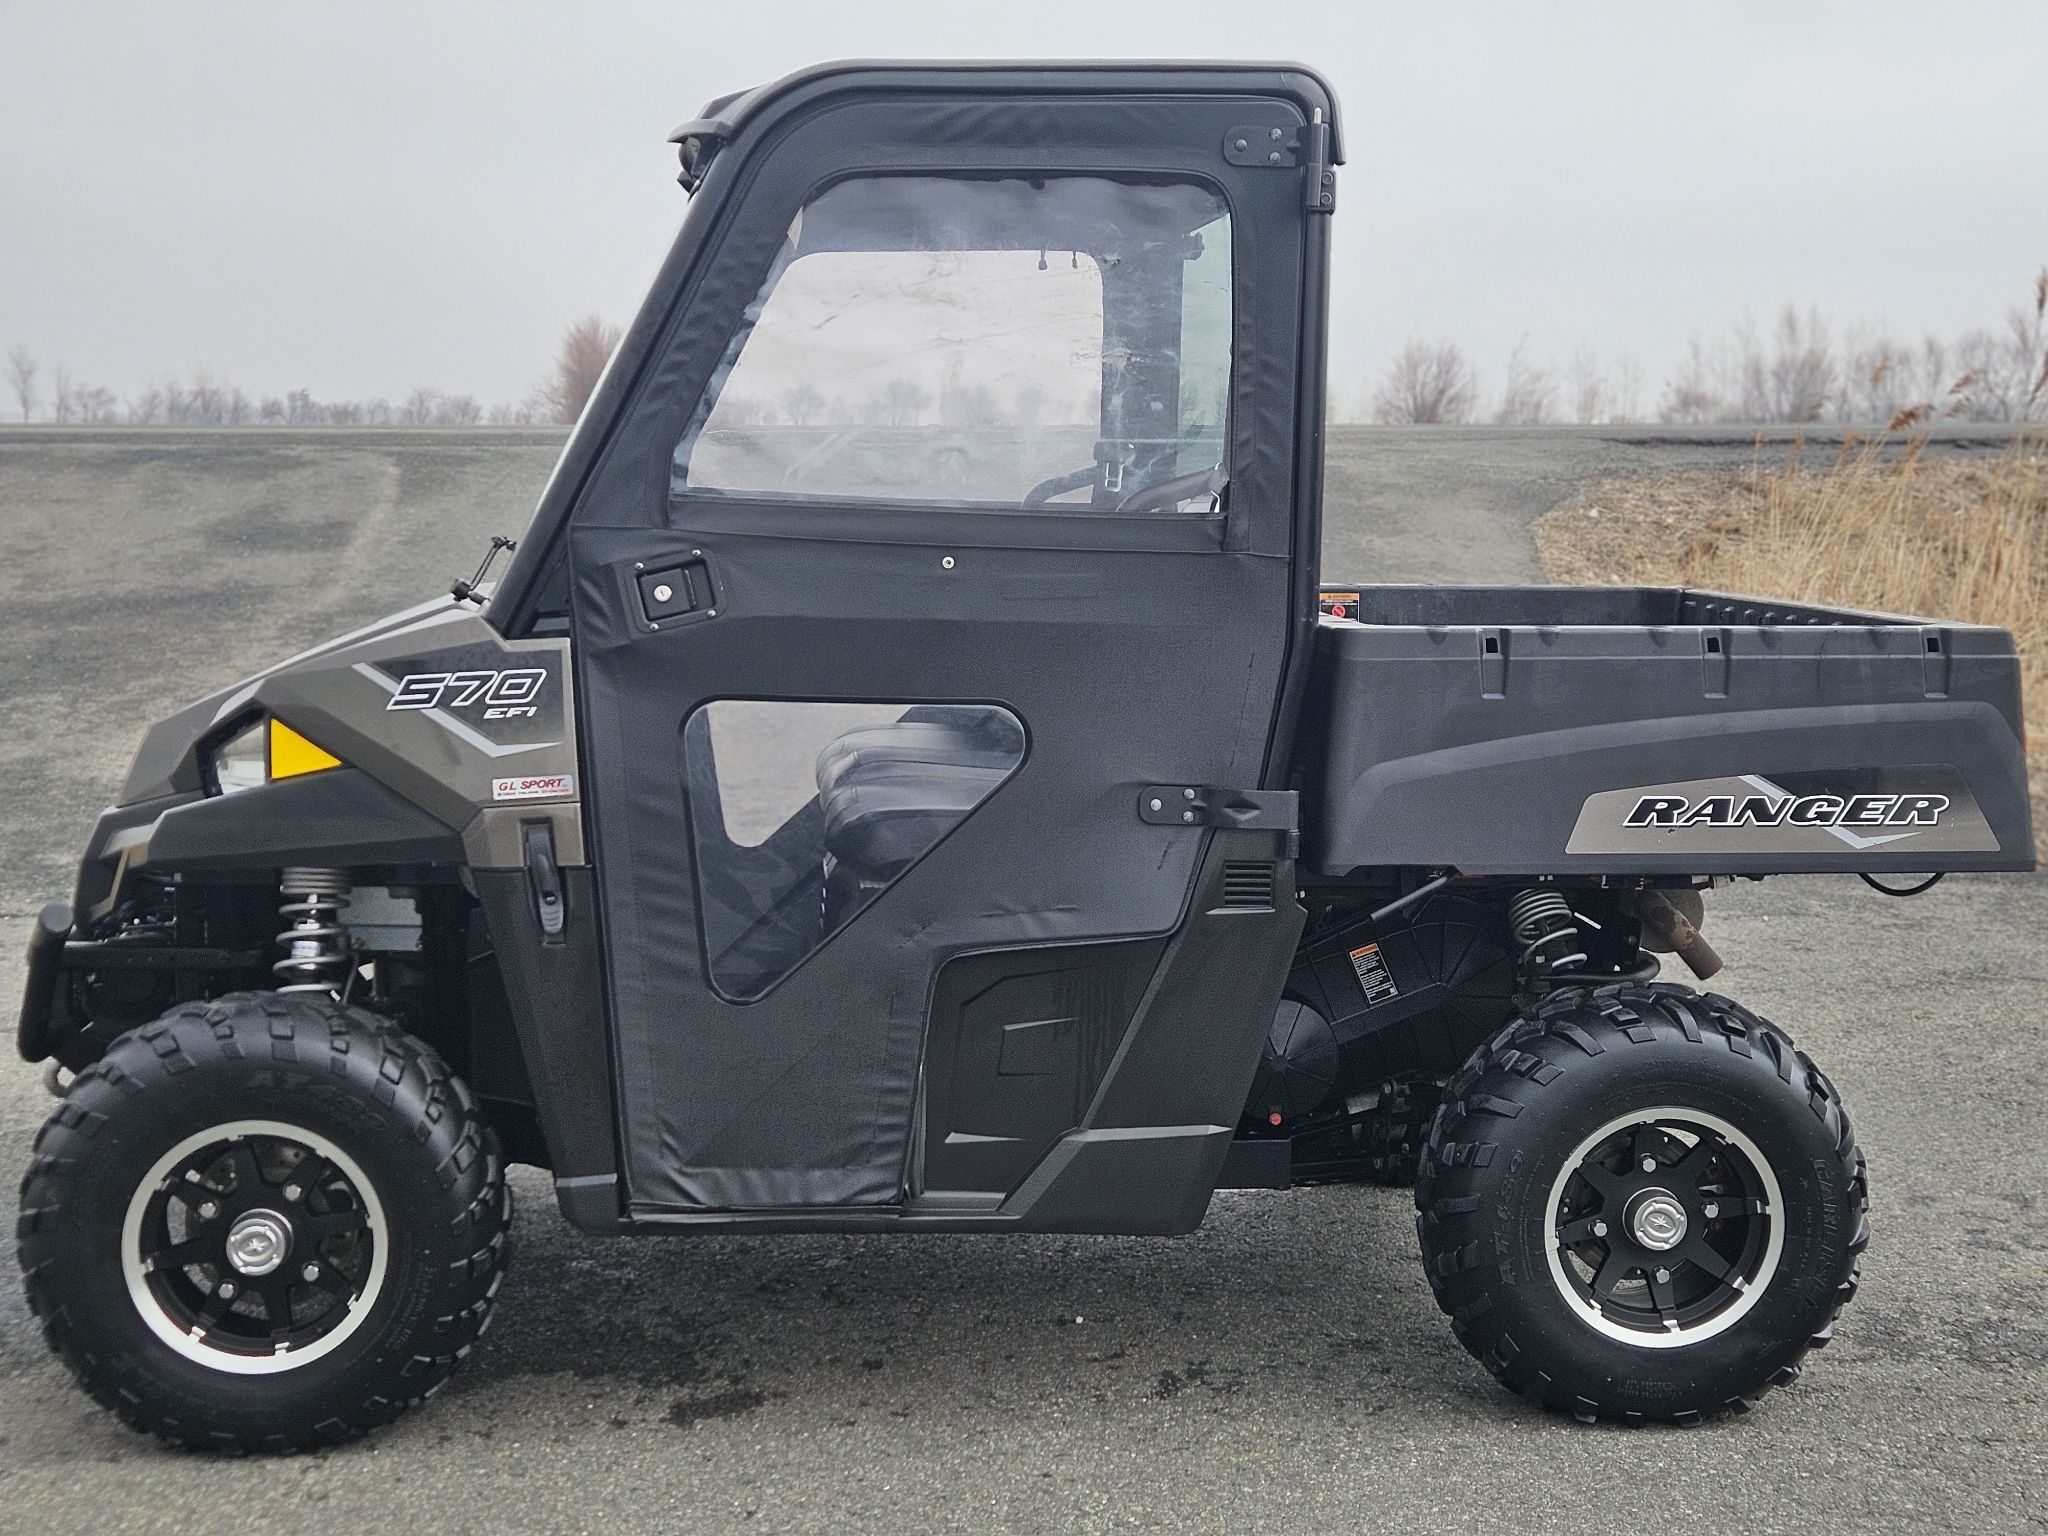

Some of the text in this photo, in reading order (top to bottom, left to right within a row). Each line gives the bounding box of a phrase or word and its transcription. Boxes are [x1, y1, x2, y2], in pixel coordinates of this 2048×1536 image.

[387, 668, 547, 711] 570
[483, 706, 538, 719] EFI
[498, 778, 564, 791] GL SPORT
[1622, 794, 1949, 827] RANGER
